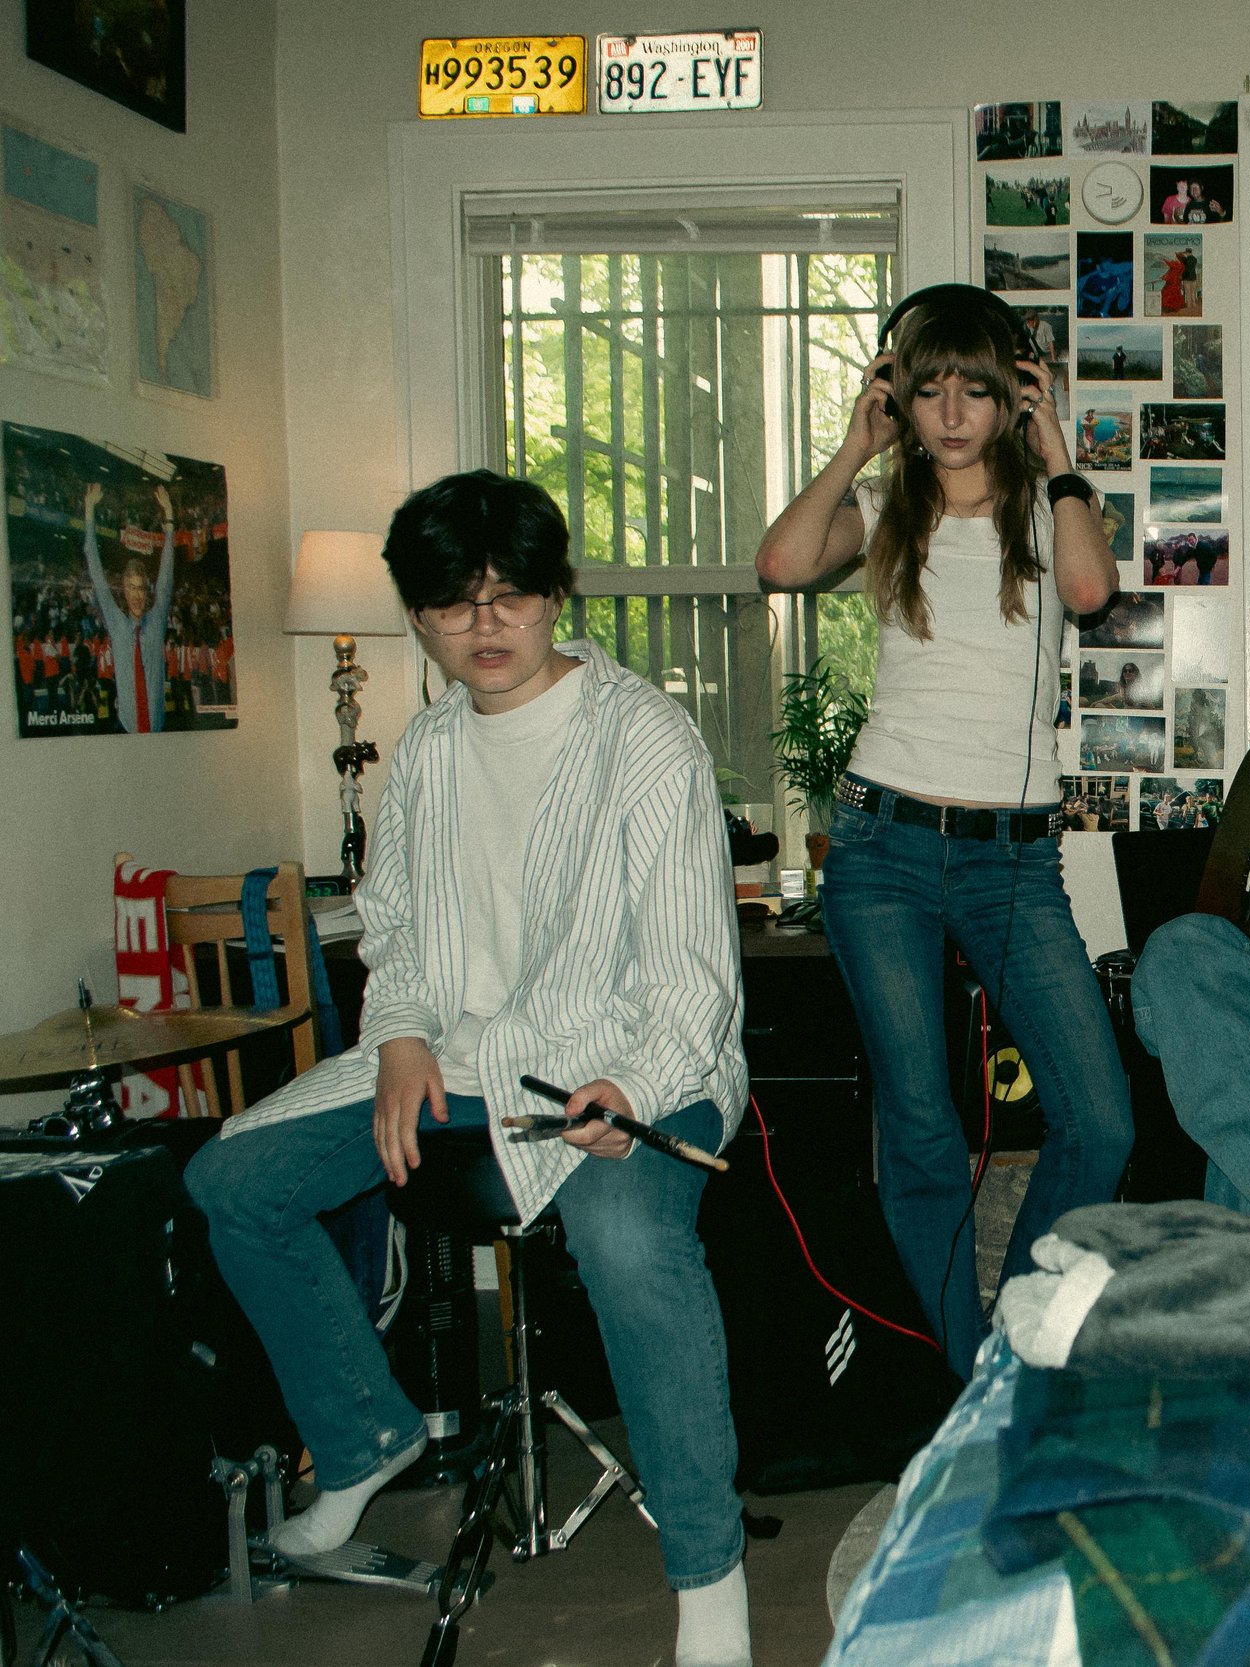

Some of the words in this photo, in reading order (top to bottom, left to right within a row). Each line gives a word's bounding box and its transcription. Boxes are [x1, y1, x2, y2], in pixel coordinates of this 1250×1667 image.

[474, 41, 532, 54] OREGON
[642, 40, 722, 56] Washington
[425, 55, 578, 91] H993539
[1076, 462, 1093, 470] NICE
[27, 710, 58, 727] Merci
[59, 709, 95, 725] Arsène
